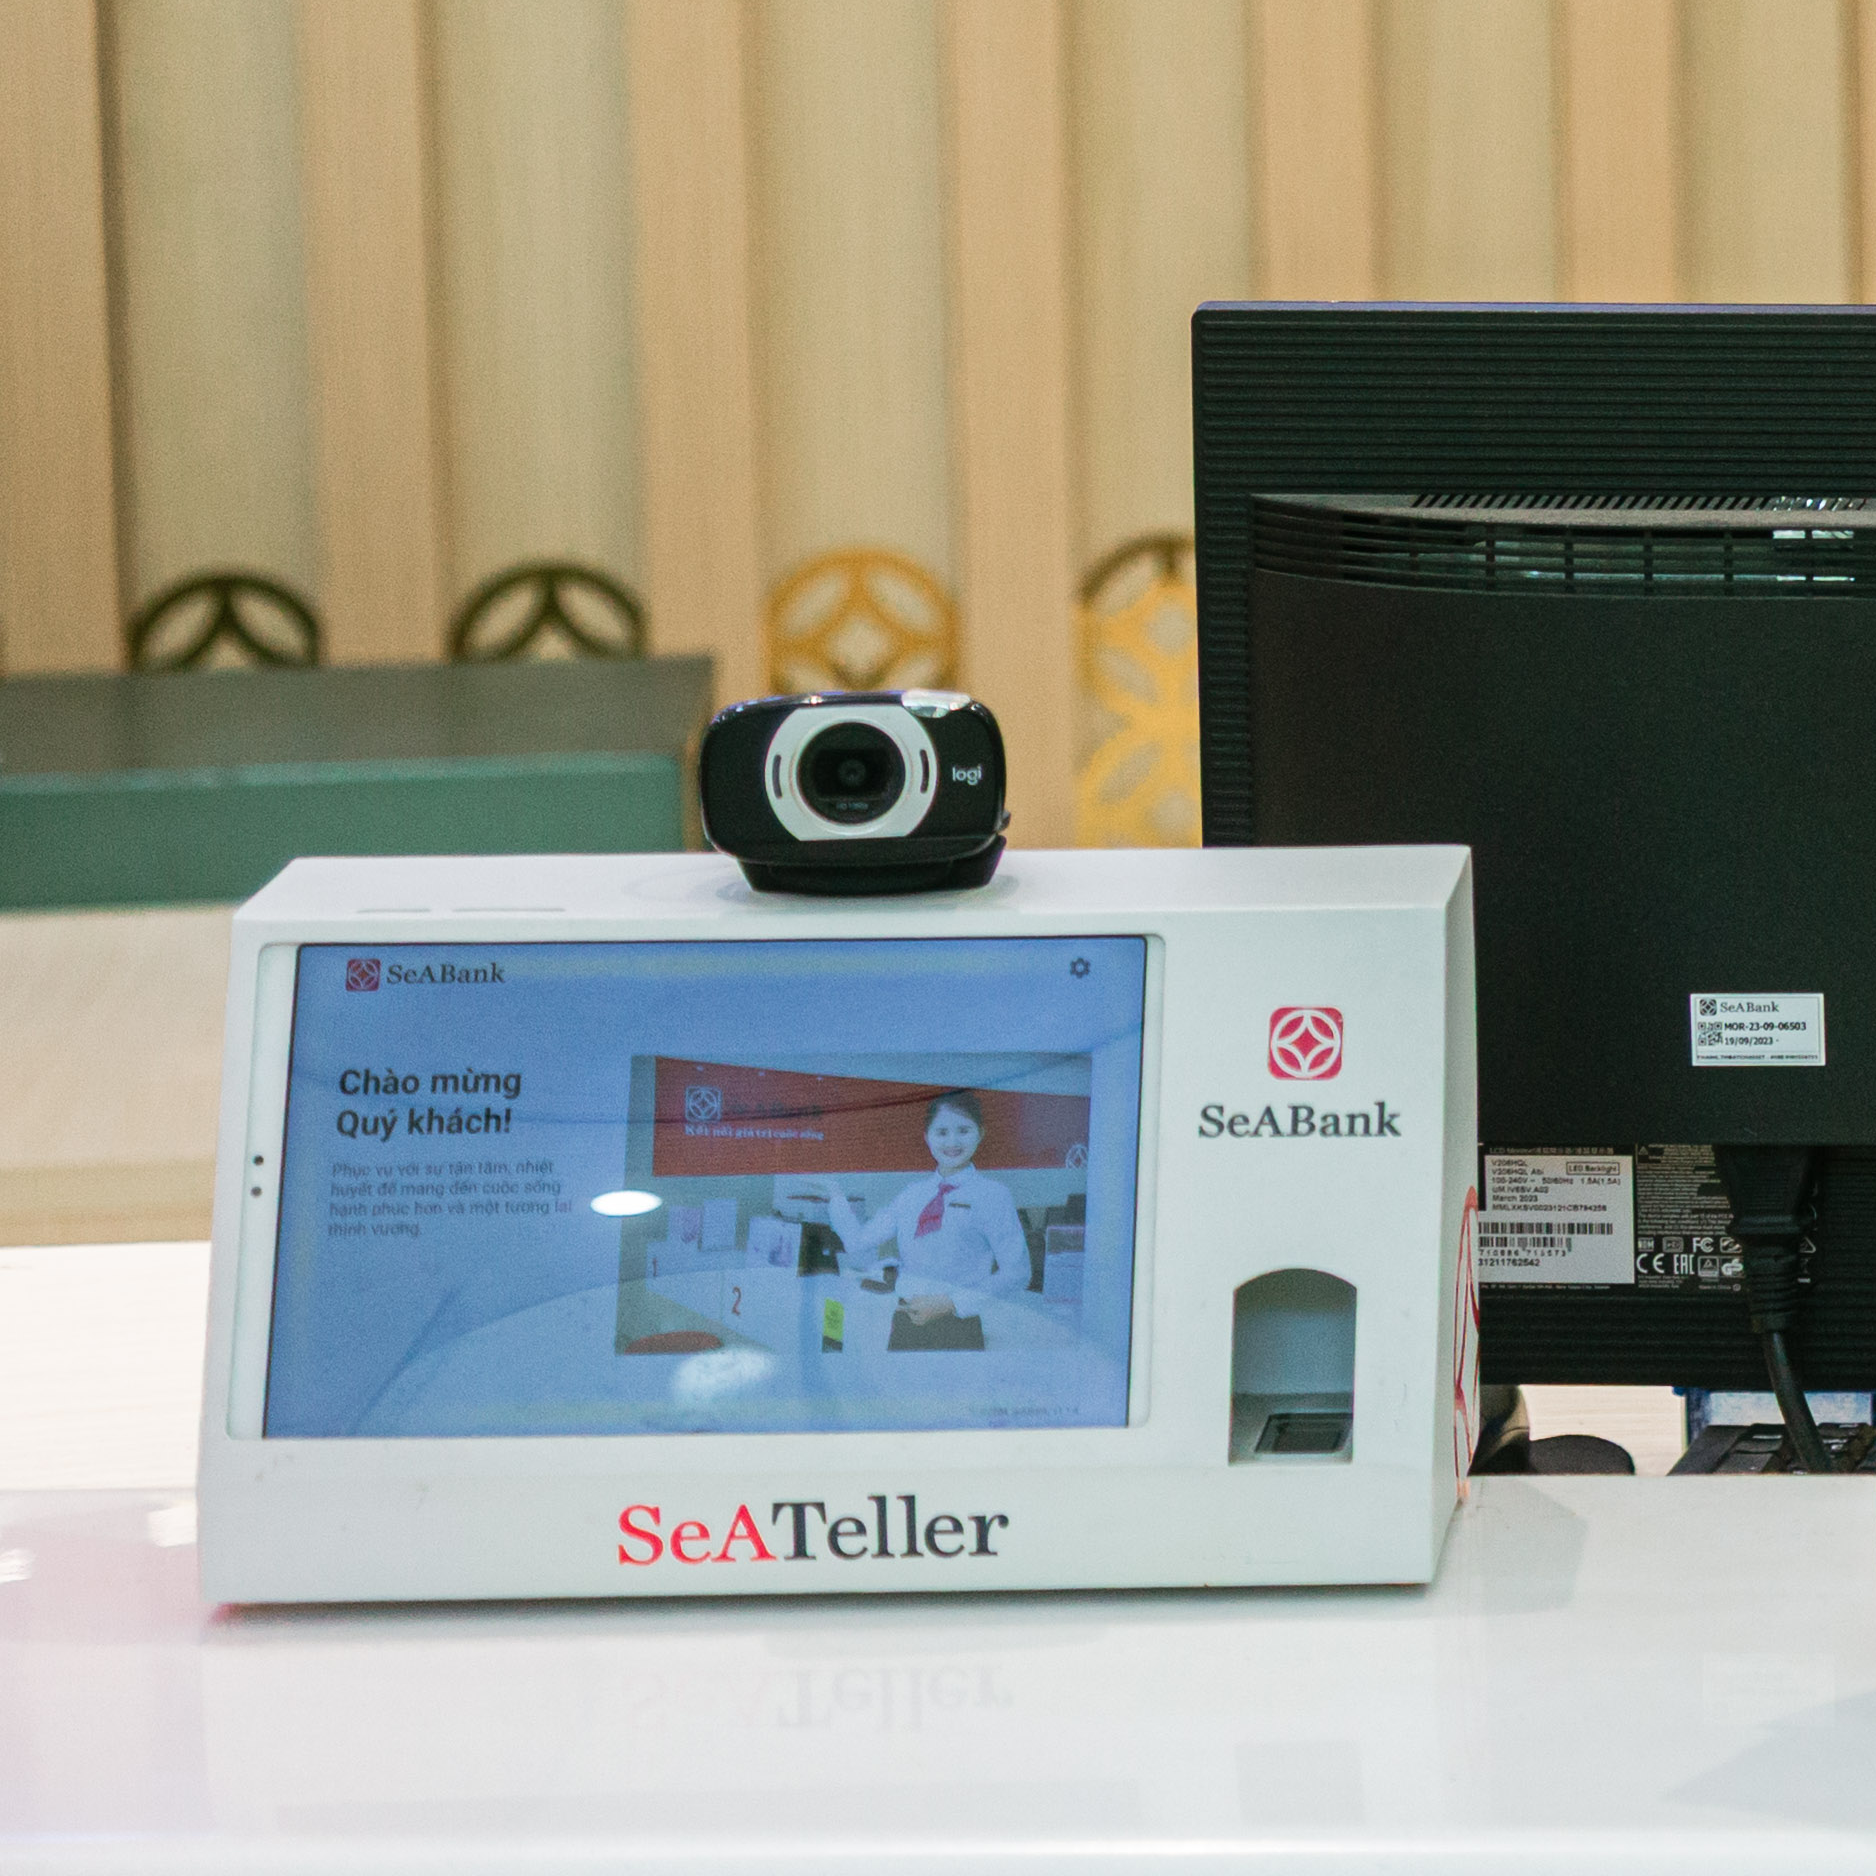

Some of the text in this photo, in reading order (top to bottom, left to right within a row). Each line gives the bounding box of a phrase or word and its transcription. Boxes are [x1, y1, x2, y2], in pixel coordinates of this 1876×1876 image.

[951, 764, 983, 786] logi
[386, 962, 506, 985] SeABank
[1720, 1001, 1780, 1013] SeABank
[1724, 1022, 1807, 1032] MOR-23-09-06503
[1724, 1037, 1774, 1046] 19/09/2023
[339, 1067, 522, 1100] Chào mừng
[336, 1107, 512, 1142] Quý khách!
[1198, 1102, 1402, 1141] SeABank
[401, 1184, 445, 1199] mang
[617, 1495, 1010, 1567] SeATeller
